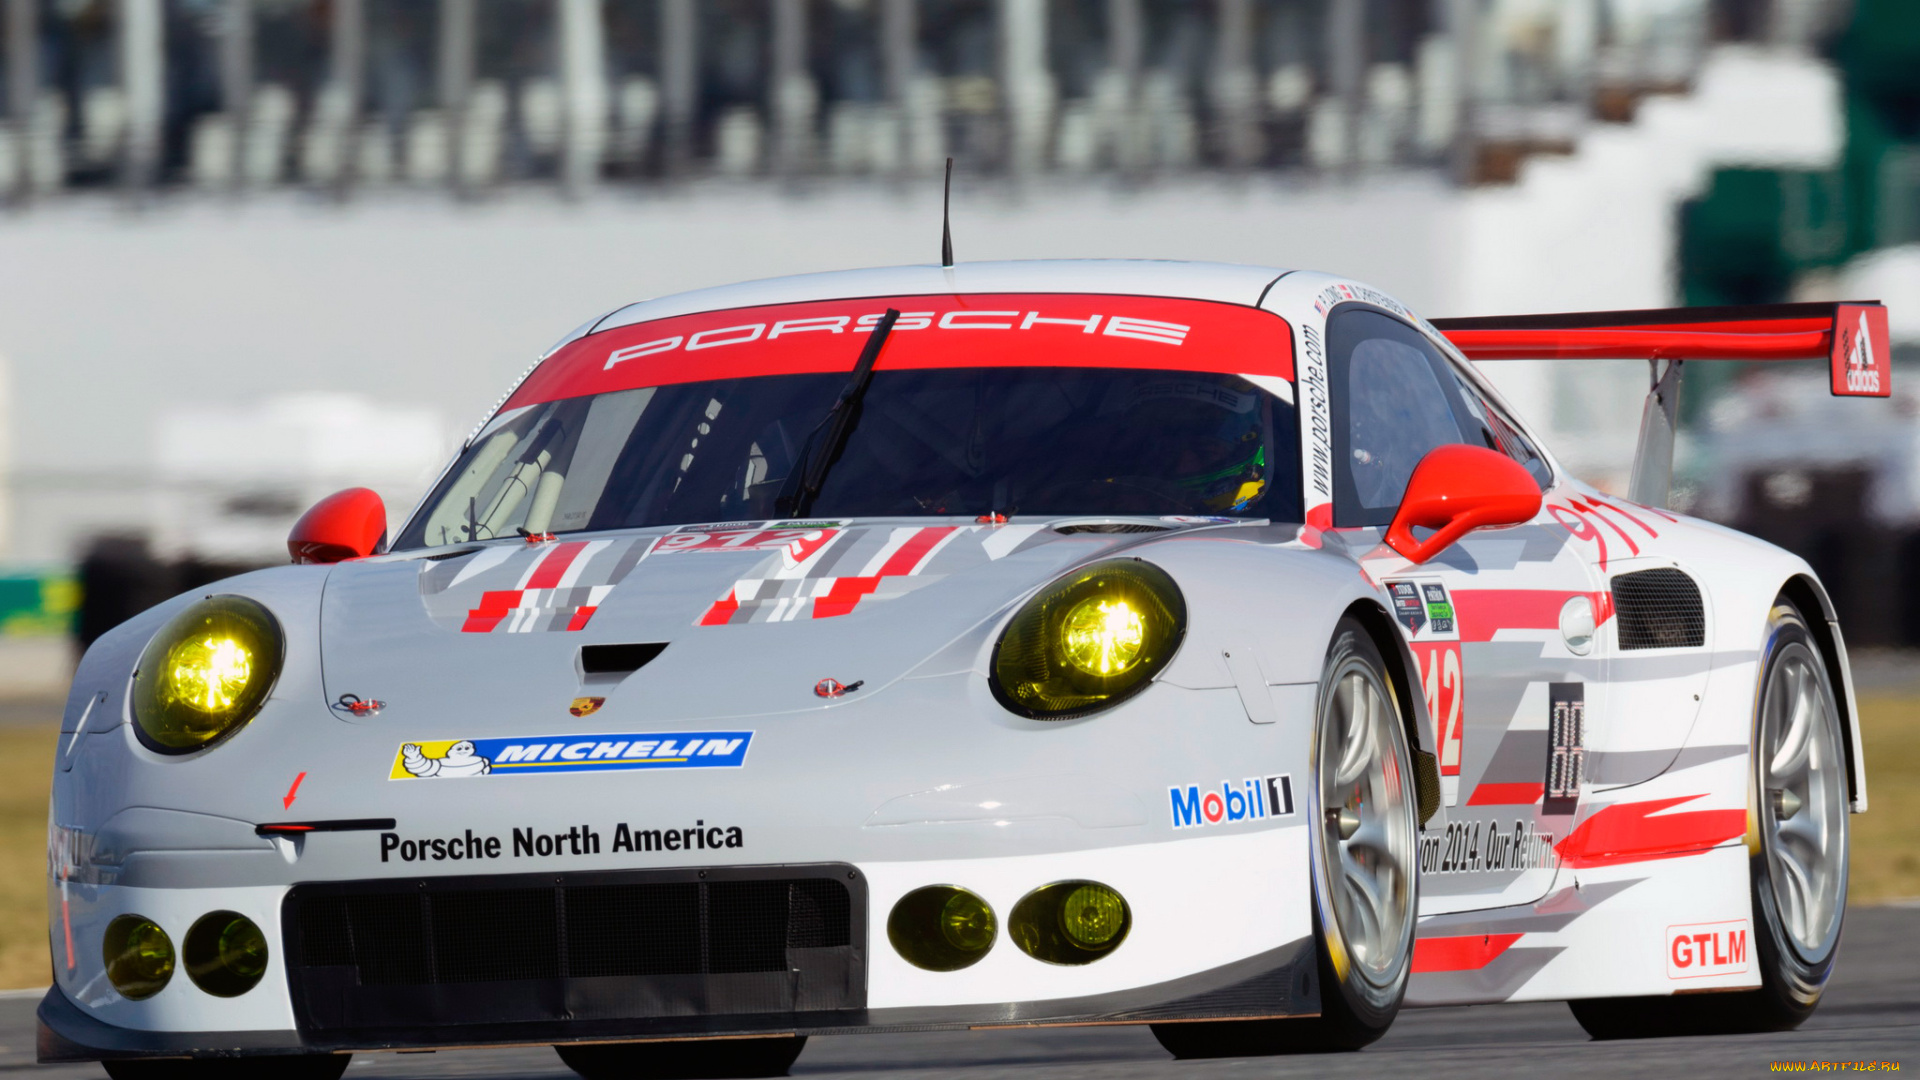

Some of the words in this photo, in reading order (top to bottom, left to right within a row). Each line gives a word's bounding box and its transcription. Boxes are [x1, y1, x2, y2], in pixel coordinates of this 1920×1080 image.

[603, 311, 1191, 371] PORSCHE
[1302, 324, 1331, 497] www.porsche.com
[658, 530, 823, 555] 912
[495, 739, 744, 762] MICHELIN
[1169, 779, 1265, 827] Mobil
[1271, 777, 1289, 814] 1
[381, 829, 501, 862] Porsche
[513, 825, 600, 857] North
[612, 820, 743, 852] America
[1442, 820, 1481, 871] 2014.
[1486, 819, 1510, 870] Our
[1511, 819, 1556, 869] Return.
[1672, 930, 1746, 968] GTLM
